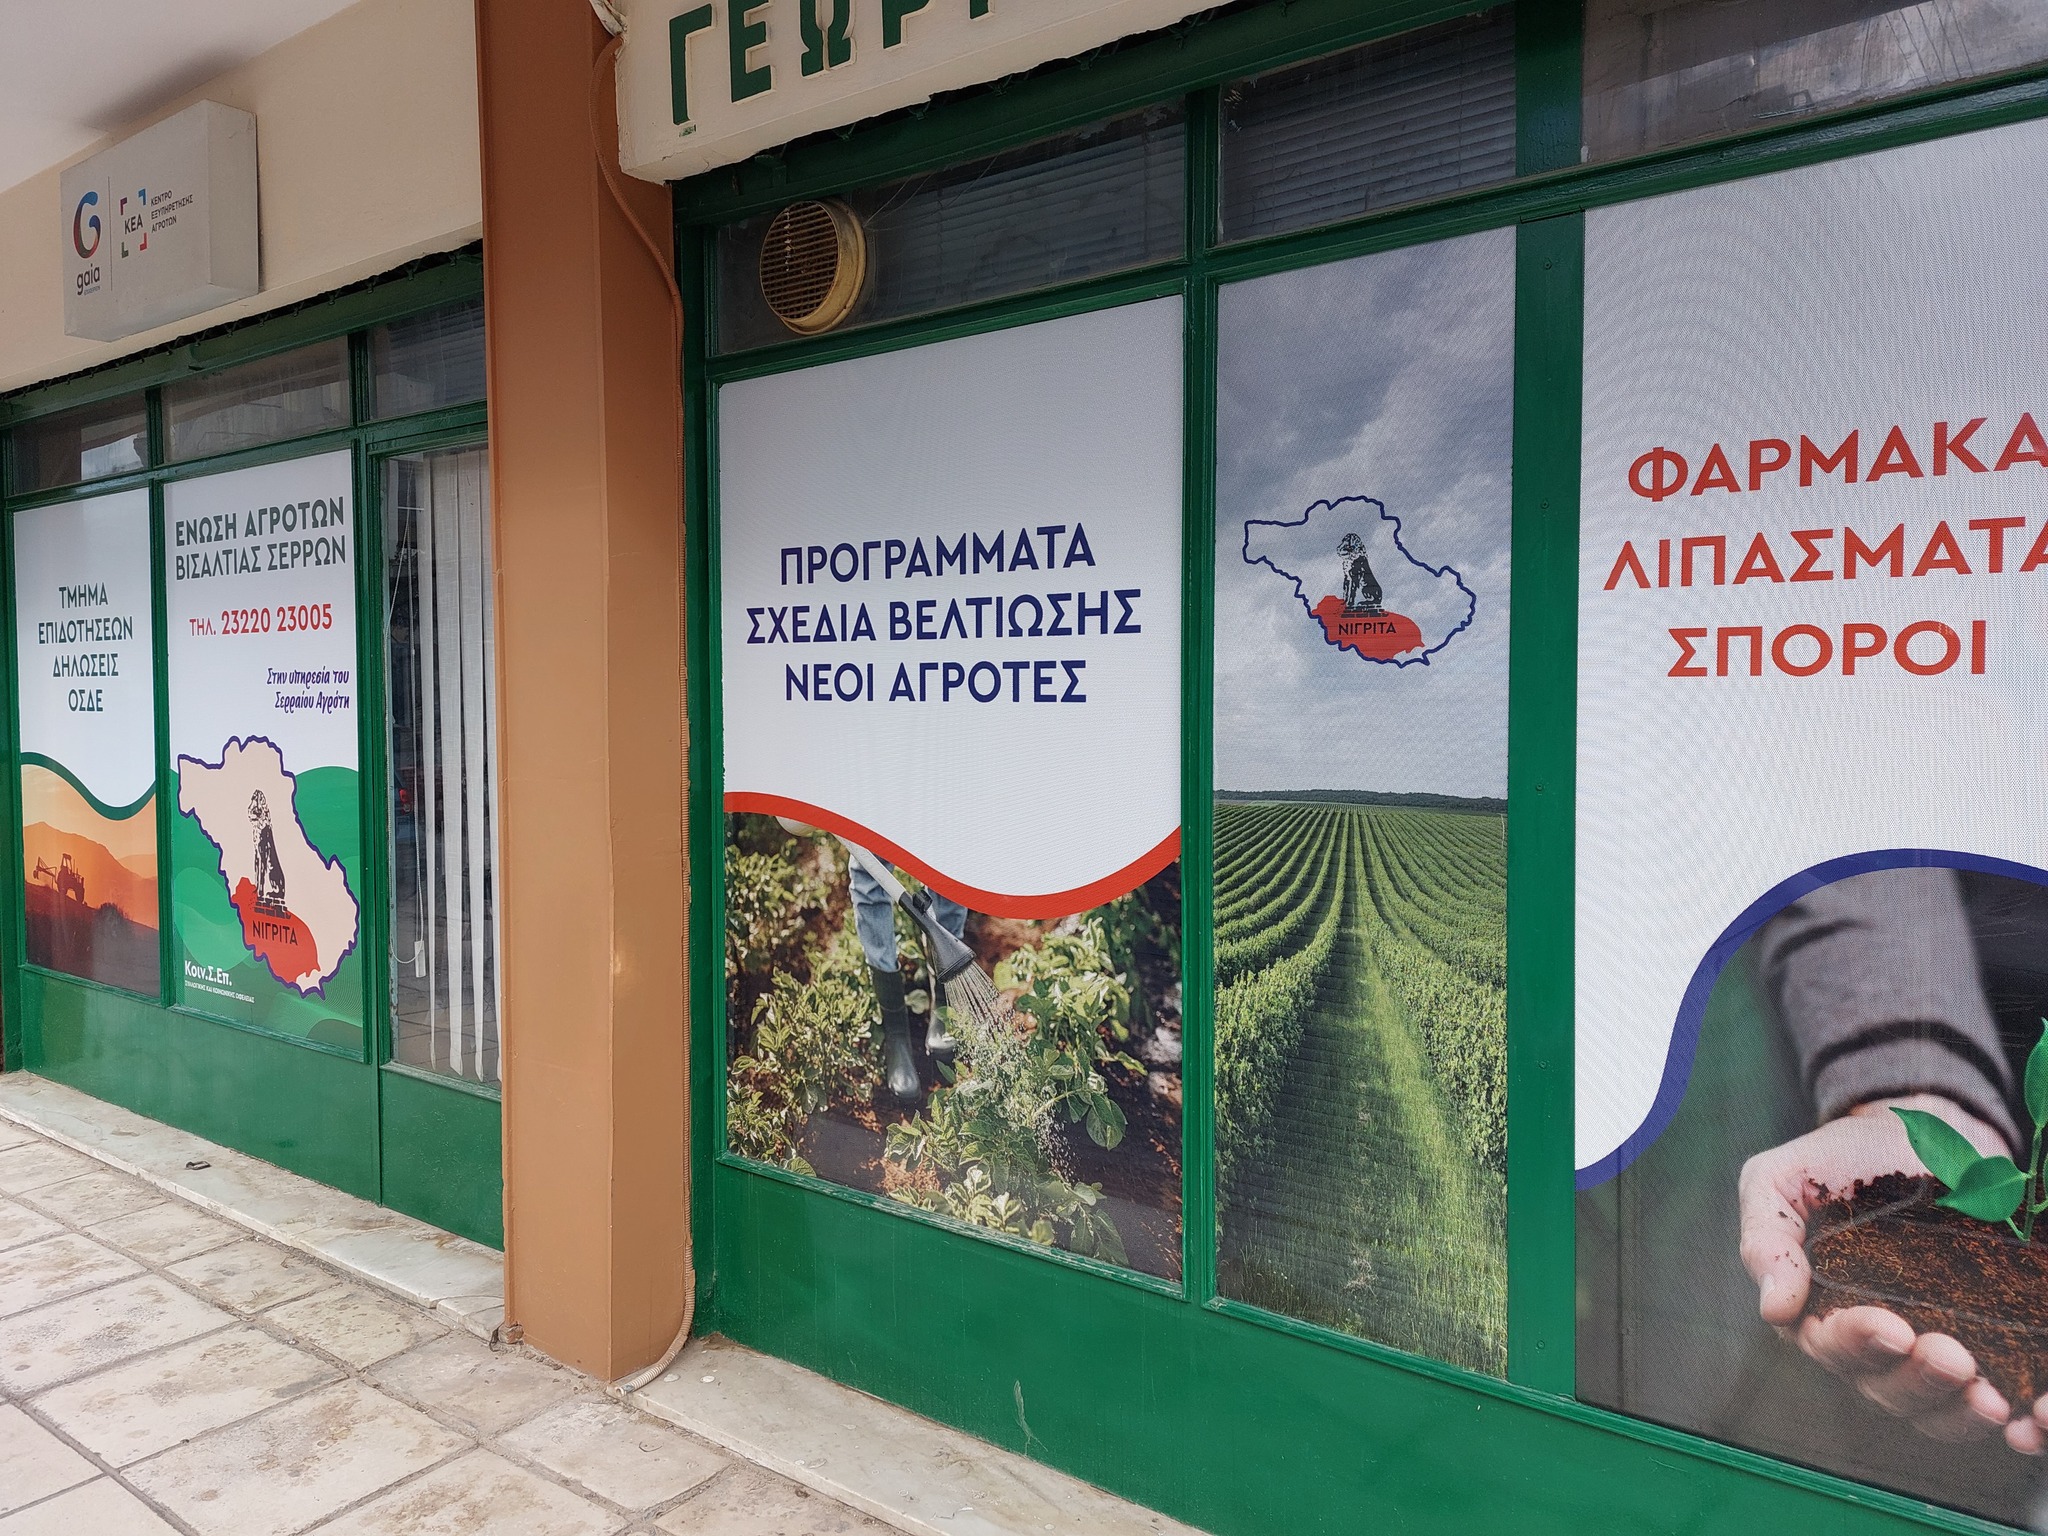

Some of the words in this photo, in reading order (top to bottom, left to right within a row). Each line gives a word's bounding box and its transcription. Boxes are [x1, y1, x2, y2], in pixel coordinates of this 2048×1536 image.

[669, 0, 989, 126] ΓΕΩ
[151, 190, 173, 207] ΚΕΝΤΡΟ
[151, 194, 194, 220] ΕΞΥΠΗΡΕΤΗΣΗΣ
[124, 213, 144, 235] ΚΕΑ
[151, 215, 177, 233] ΑΓΡΟΤΩΝ
[76, 263, 100, 296] gaia
[1628, 412, 2048, 502] ΦΑΡΜΑΚΑ
[175, 513, 238, 547] ΕΝΩΣΗ
[244, 496, 345, 539] ΑΓΡΟΤΩΝ
[176, 546, 262, 580] ΒΙΣΑΛΤΙΑΣ
[267, 535, 346, 571] ΣΕΡΡΩΝ
[781, 522, 1096, 585] ΠΡΟΓΡΑΜΜΑΤΑ
[59, 582, 108, 609] ΤΜΗΜΑ
[189, 615, 217, 637] ΤΗΛ.
[221, 608, 271, 635] 23220
[276, 603, 333, 632] 23005
[747, 602, 876, 644] ΣΧΕΔΙΑ
[889, 588, 1142, 641] ΒΕΛΤΙΩΣΗΣ
[1338, 621, 1397, 636] ΝΙΓΡΙΤΑ
[38, 616, 133, 645] ΕΠΙΔΟΤΗΣΕΩΝ
[1667, 620, 1986, 677] ΣΠΟΡΟΙ
[53, 653, 119, 678] ΔΗΛΩΣΕΙΣ
[266, 667, 288, 685] Στην
[288, 665, 331, 690] υπηρεσία
[332, 670, 350, 684] του
[785, 662, 874, 702] ΝΕΟΙ
[889, 660, 1087, 703] ΑΓΡΟΤΕΣ
[68, 689, 104, 712] ΟΣΔΕ
[274, 690, 315, 714] Σερραίου
[315, 689, 350, 715] Αγρότη
[252, 919, 298, 946] ΝΙΓΡΙΤΑ
[184, 960, 233, 987] Κοιν.Σ.Επ.
